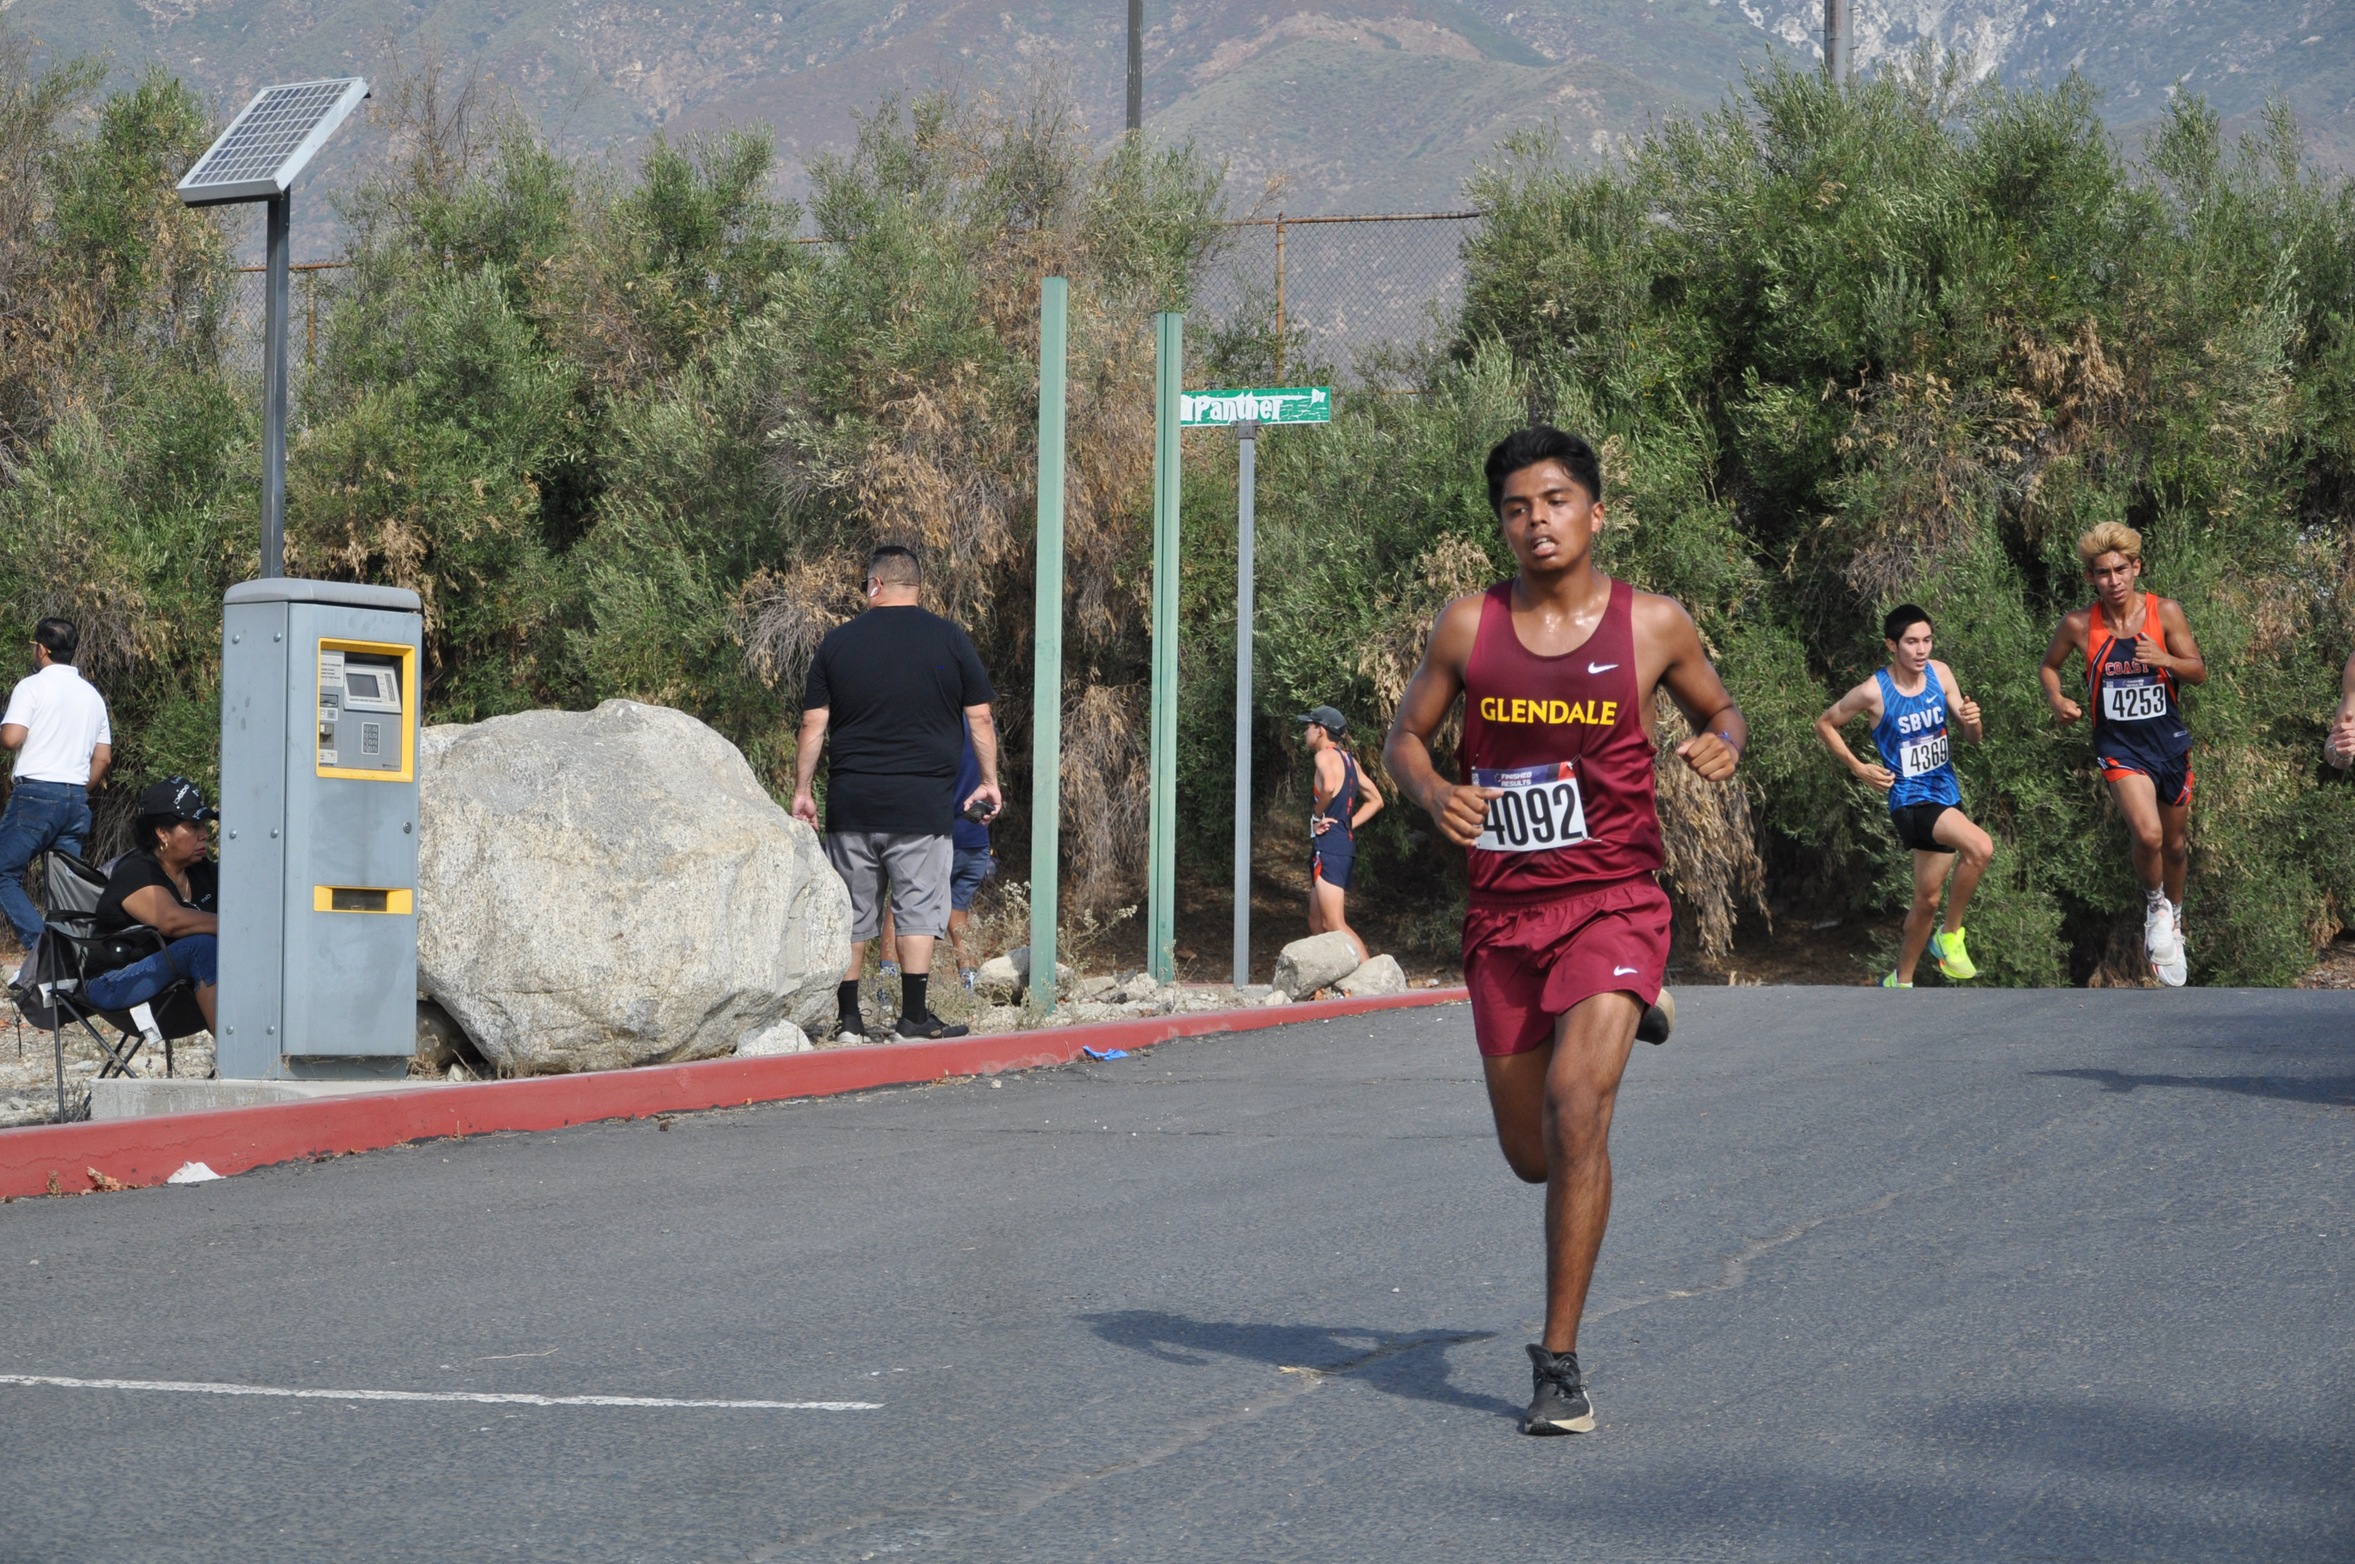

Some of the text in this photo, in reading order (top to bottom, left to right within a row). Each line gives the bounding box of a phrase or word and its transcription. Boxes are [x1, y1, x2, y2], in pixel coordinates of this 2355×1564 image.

[1195, 391, 1283, 421] Panther
[1480, 697, 1617, 725] GLENDALE
[2112, 686, 2165, 718] 4253
[1898, 706, 1944, 734] SBVC
[1910, 738, 1947, 772] 4369
[1501, 771, 1532, 779] FINISHED
[1483, 783, 1583, 845] 4092
